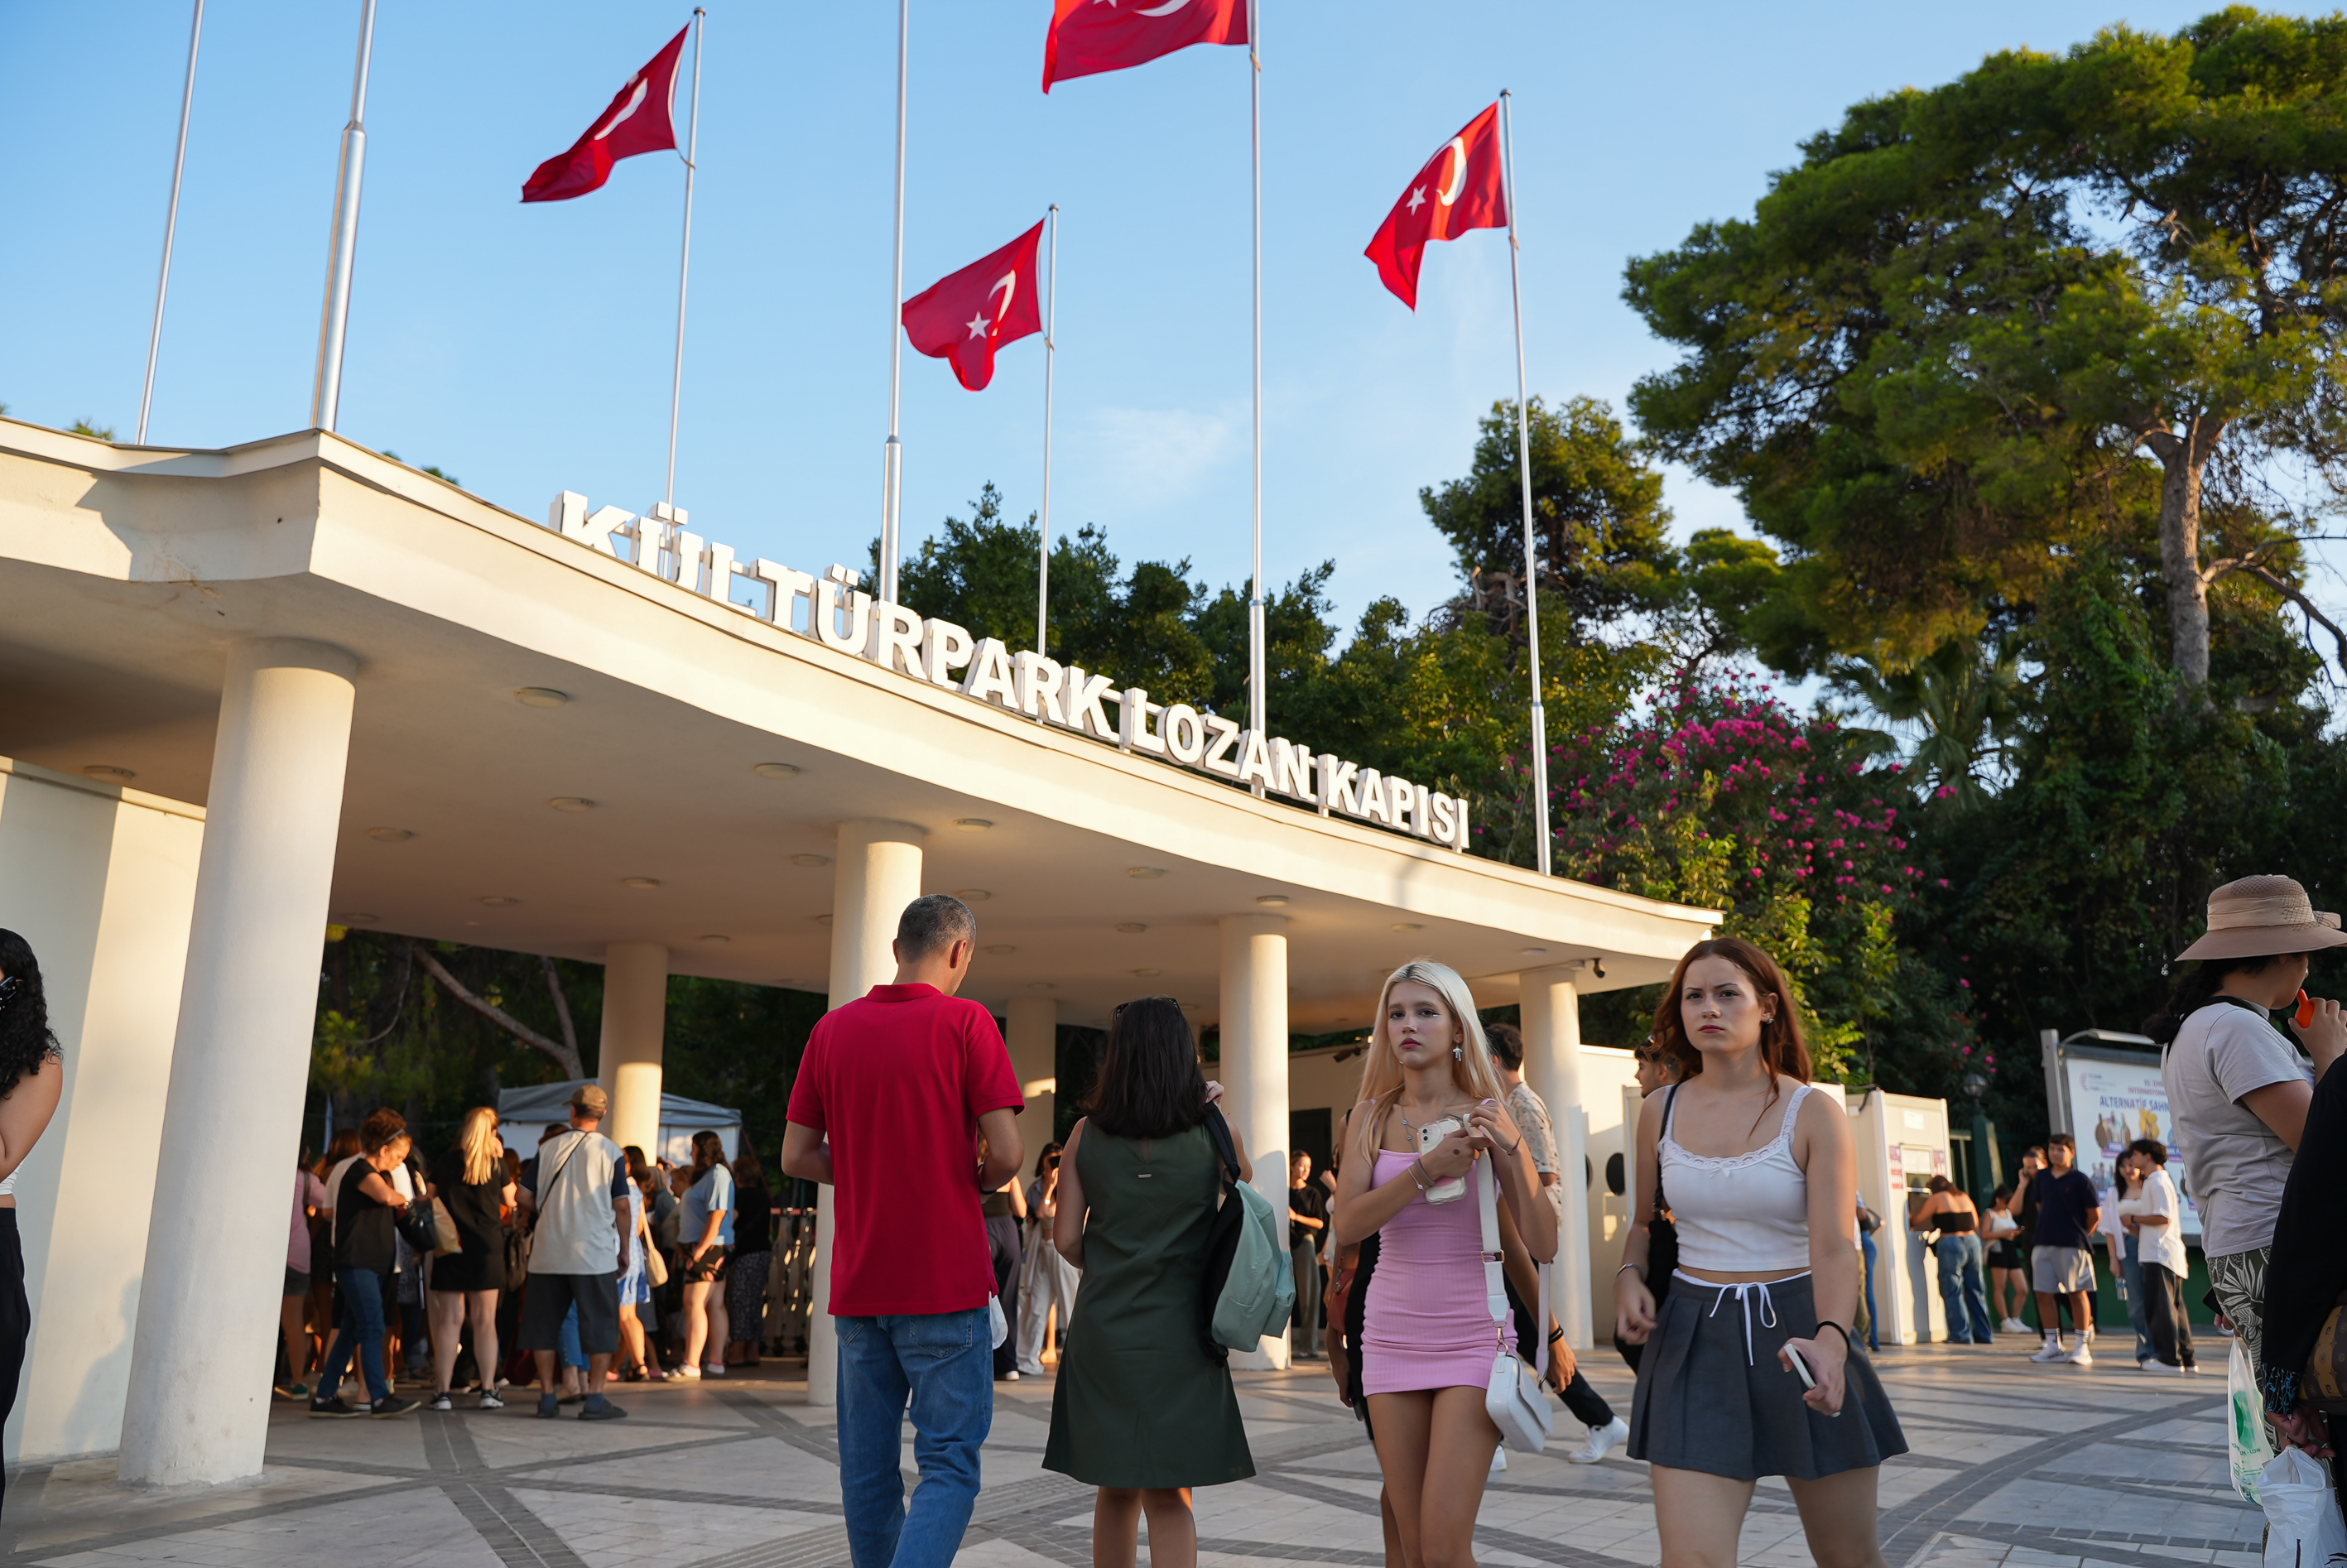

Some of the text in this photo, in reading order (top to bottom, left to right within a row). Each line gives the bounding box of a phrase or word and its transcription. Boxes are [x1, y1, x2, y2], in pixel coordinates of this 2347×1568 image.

[550, 489, 1470, 849] KÜLTÜRPARK LOZAN KAPISI
[2149, 1099, 2169, 1112] SAHN
